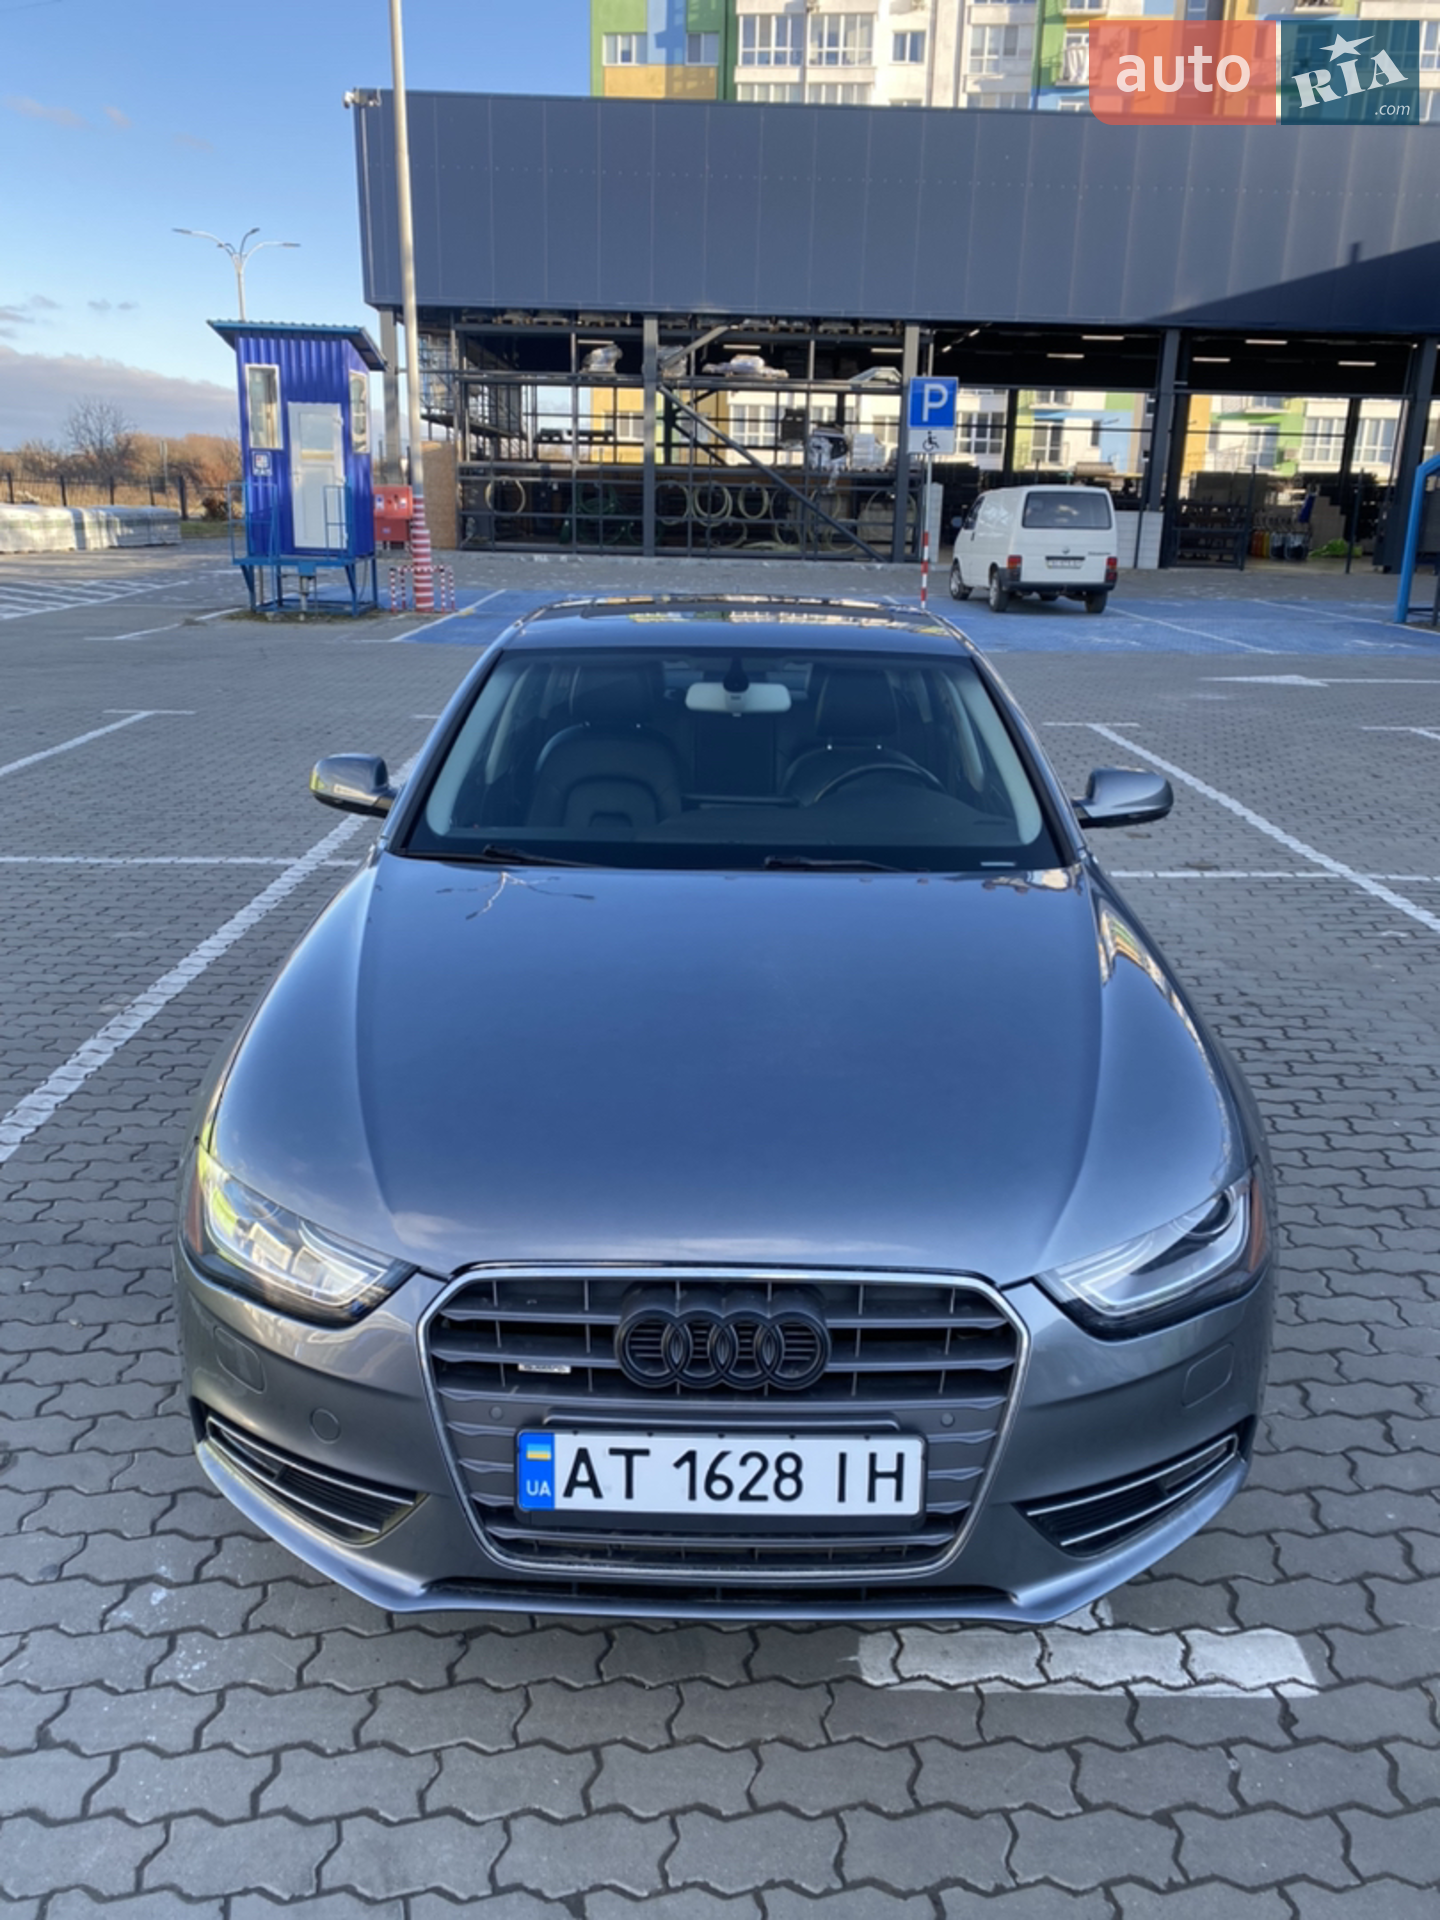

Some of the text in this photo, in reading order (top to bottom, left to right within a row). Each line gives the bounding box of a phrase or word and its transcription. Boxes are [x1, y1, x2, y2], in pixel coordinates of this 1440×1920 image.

[922, 383, 949, 422] P
[526, 1480, 551, 1497] UA
[562, 1447, 905, 1503] AT 1628 IH
